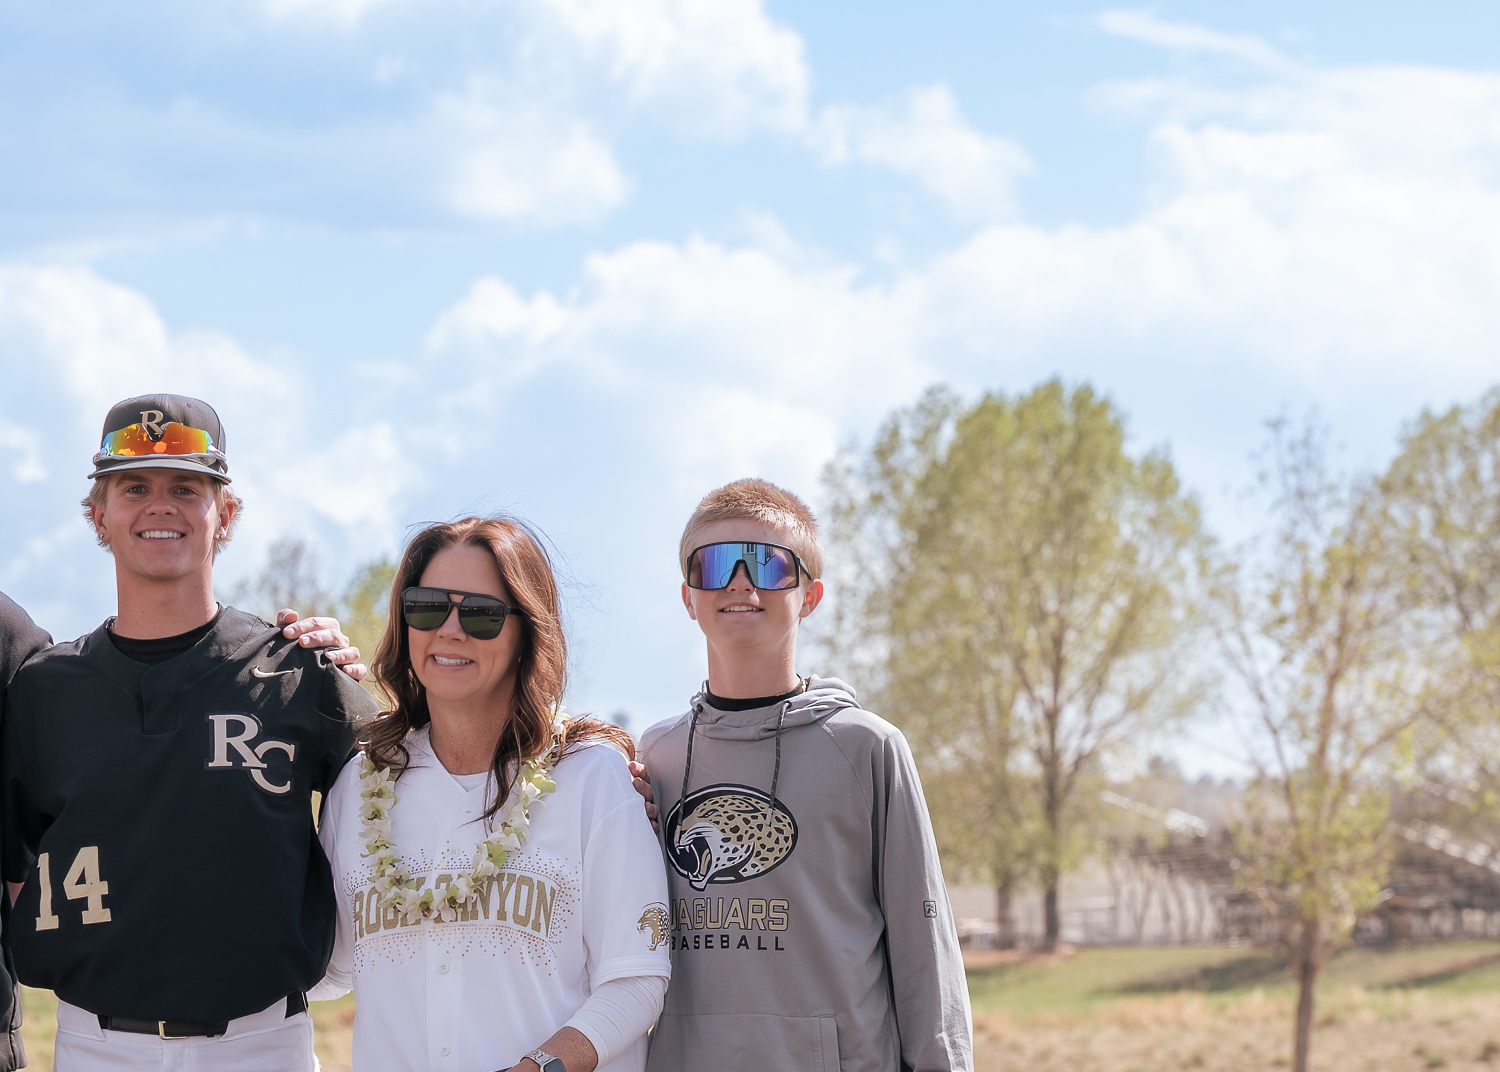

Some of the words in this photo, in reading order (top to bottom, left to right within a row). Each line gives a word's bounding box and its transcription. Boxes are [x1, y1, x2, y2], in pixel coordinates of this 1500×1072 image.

[140, 409, 168, 437] R
[208, 714, 295, 794] RC
[35, 845, 112, 931] 14
[669, 897, 790, 932] JAGUARS
[671, 934, 785, 951] BASEBALL
